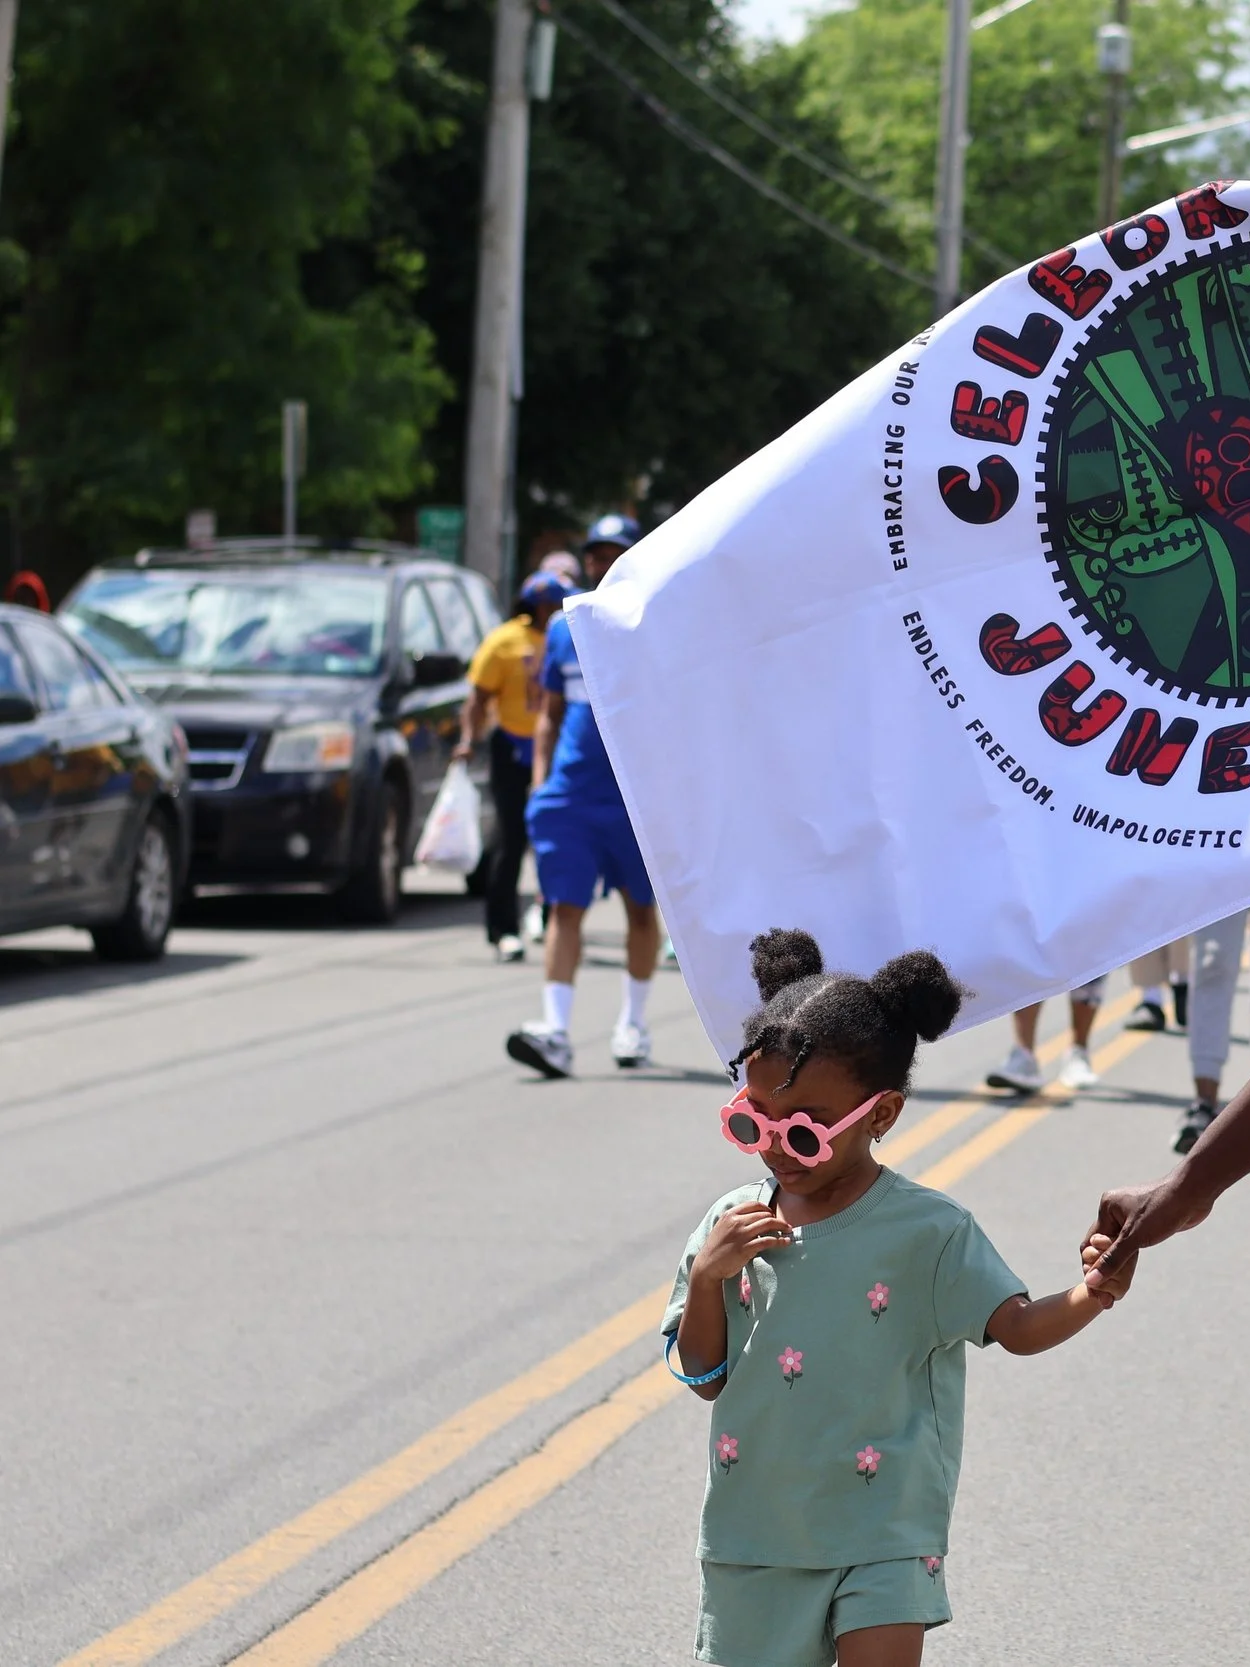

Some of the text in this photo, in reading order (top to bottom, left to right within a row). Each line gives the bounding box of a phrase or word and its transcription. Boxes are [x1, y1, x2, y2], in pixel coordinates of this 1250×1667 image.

[892, 360, 920, 406] OUR
[883, 423, 909, 572] EMBRACING
[902, 610, 965, 710] ENDLESS
[965, 718, 1055, 812] FREEDOM.
[1072, 803, 1242, 849] UNAPOLOGETIC
